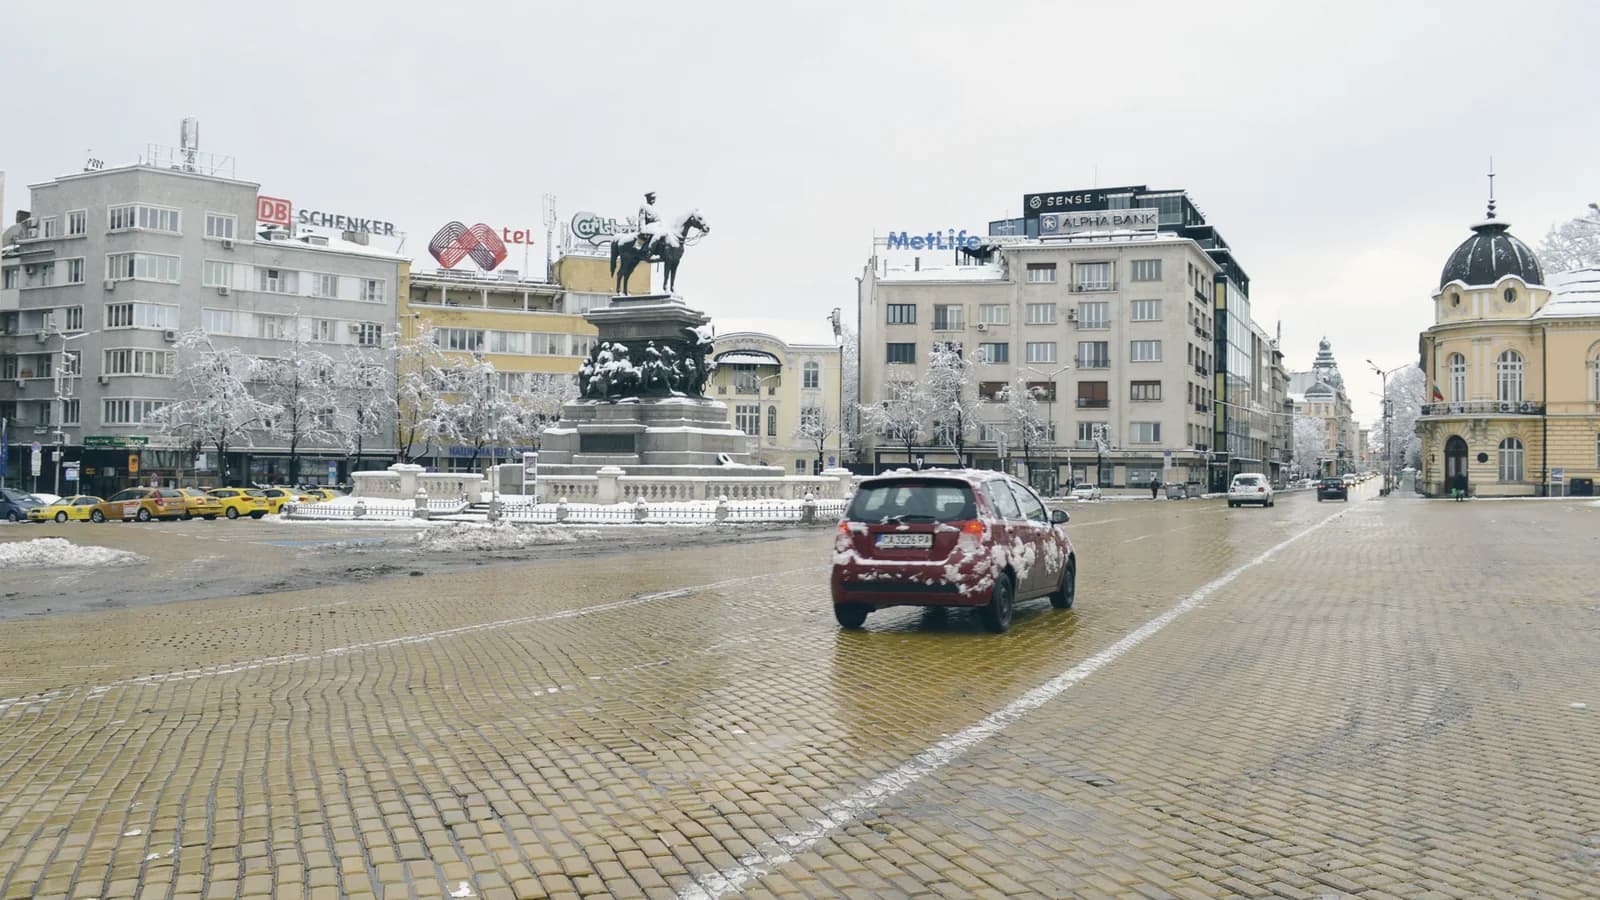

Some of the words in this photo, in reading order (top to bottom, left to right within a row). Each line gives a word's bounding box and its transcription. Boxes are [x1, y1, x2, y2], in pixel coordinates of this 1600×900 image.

[1047, 194, 1092, 206] SENSE
[260, 200, 288, 220] DB
[299, 209, 394, 236] SCHENKER
[1062, 215, 1109, 228] ALPHA
[1113, 214, 1156, 226] BANK
[886, 228, 981, 250] MetLife
